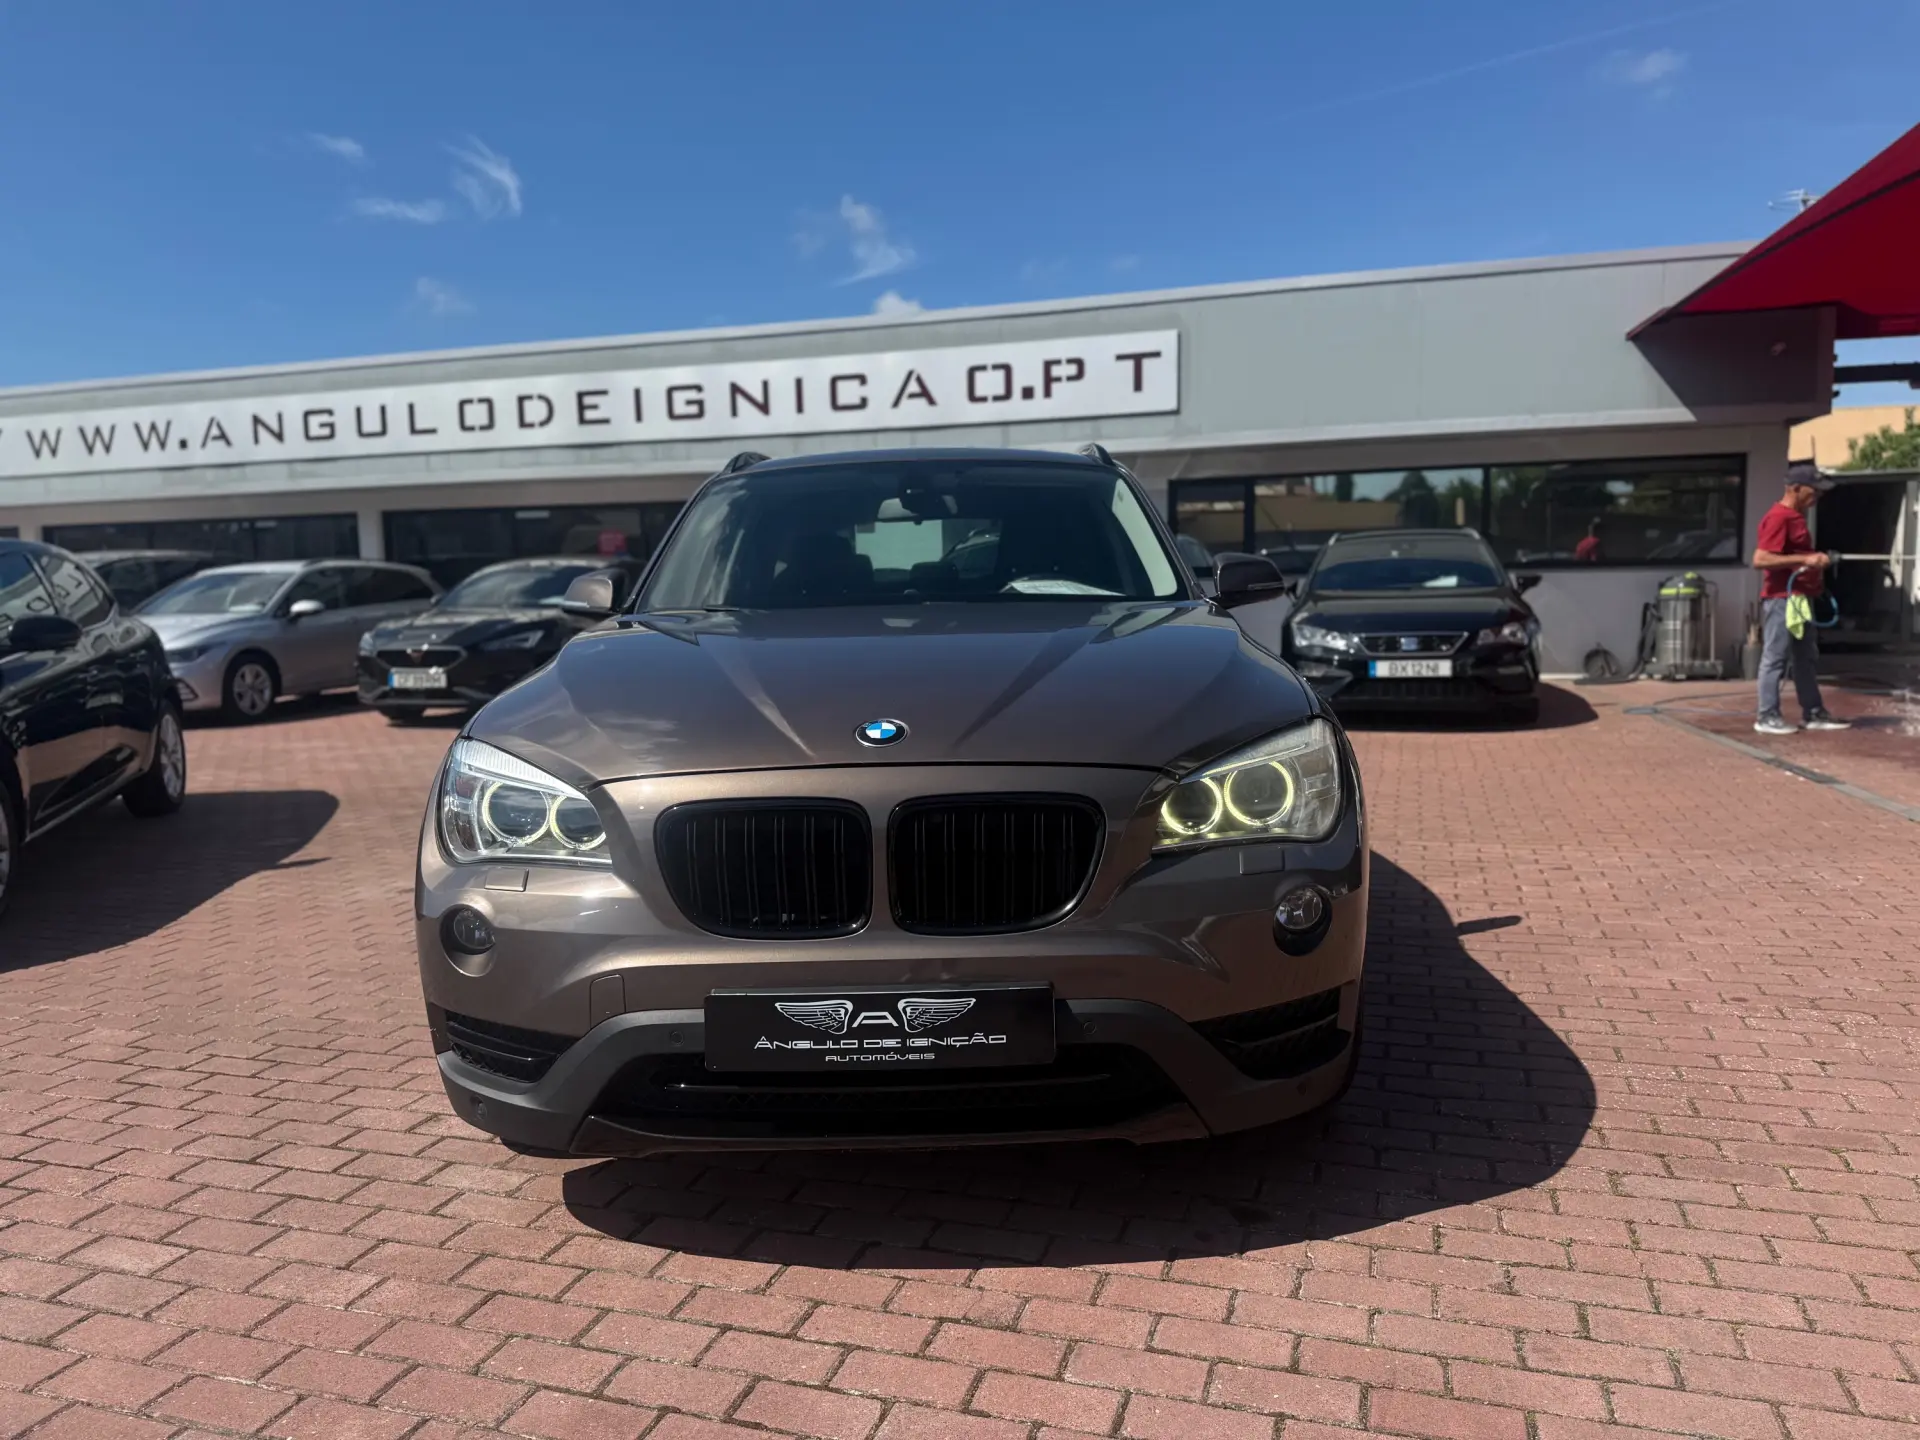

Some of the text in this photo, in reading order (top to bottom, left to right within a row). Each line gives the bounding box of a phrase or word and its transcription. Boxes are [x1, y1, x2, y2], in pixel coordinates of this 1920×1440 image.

[0, 350, 1162, 460] WWW.ANGULODEIGNICAO.PT
[754, 1031, 1007, 1050] ÂNGULO DE IGNIÇÃO
[825, 1051, 936, 1062] AUTOMÓVEIS
